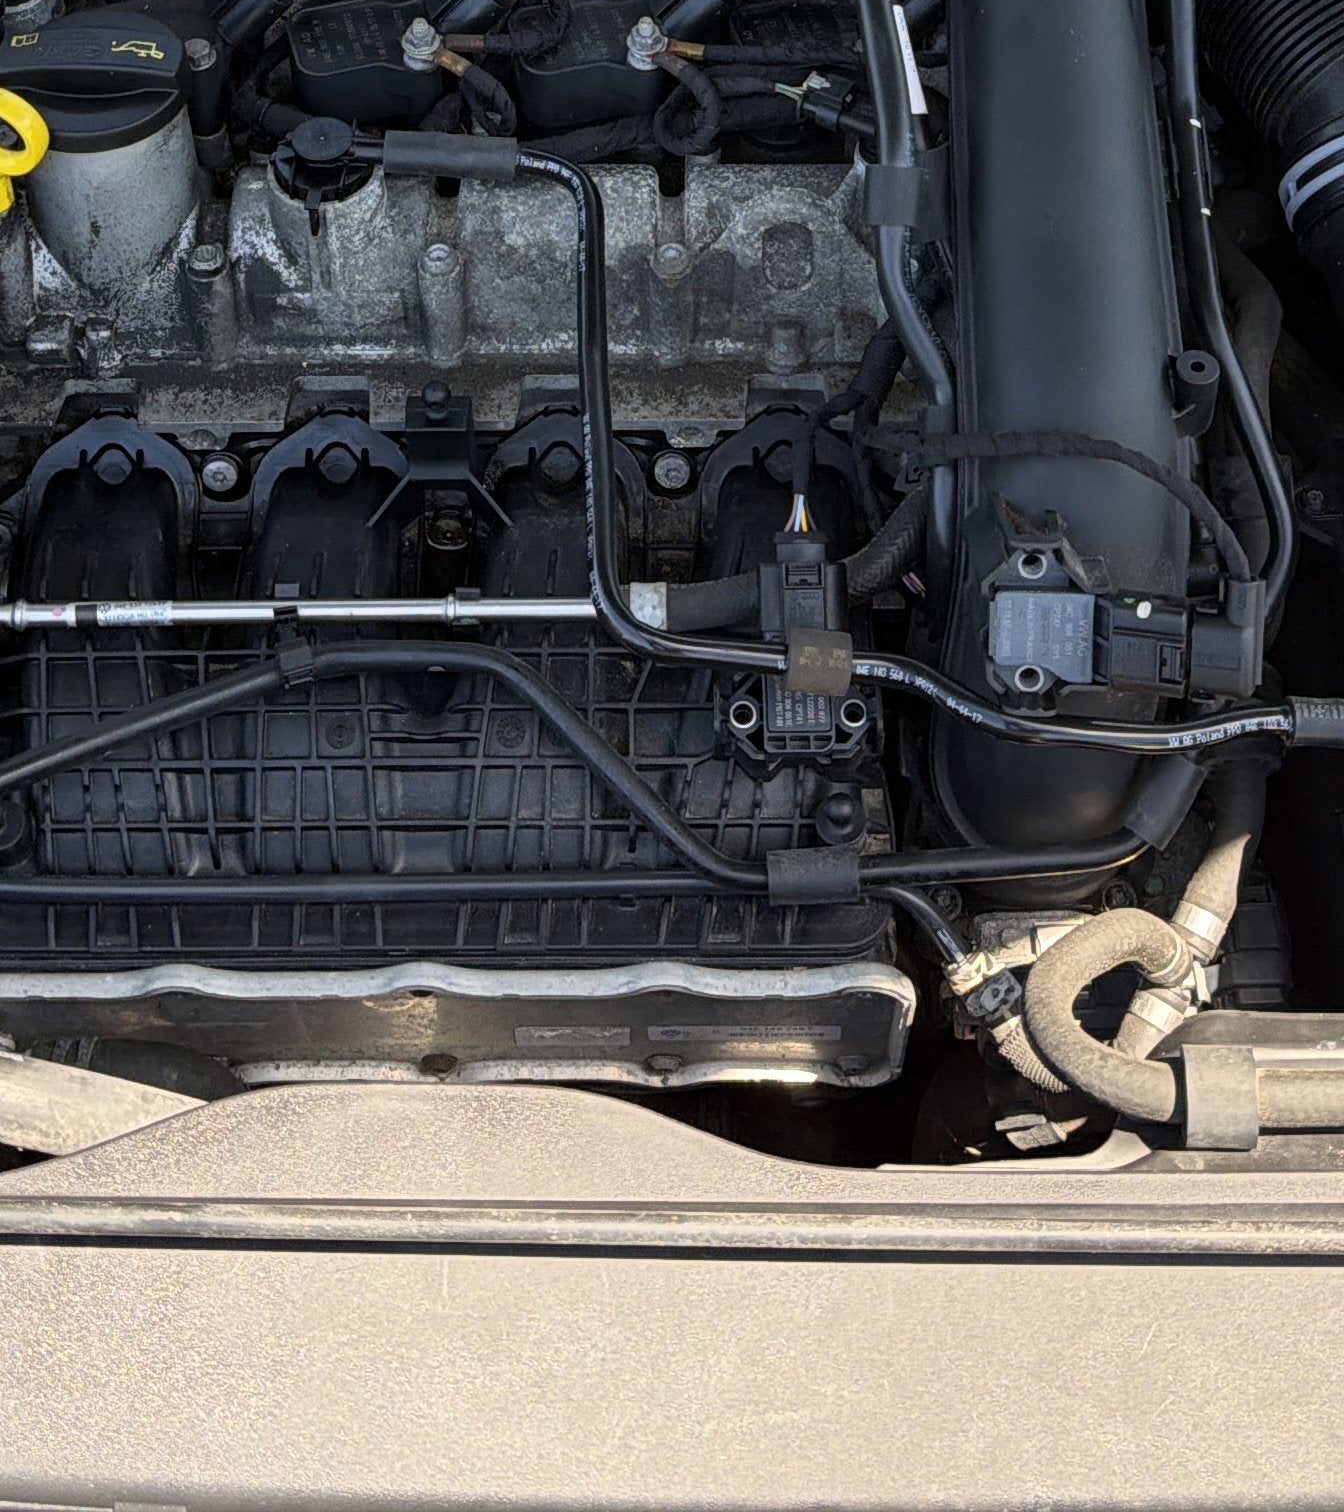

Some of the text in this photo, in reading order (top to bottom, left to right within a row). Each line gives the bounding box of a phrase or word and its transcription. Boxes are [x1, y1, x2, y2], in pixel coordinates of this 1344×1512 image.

[1078, 620, 1088, 657] VW AG
[1196, 729, 1225, 745] Poland
